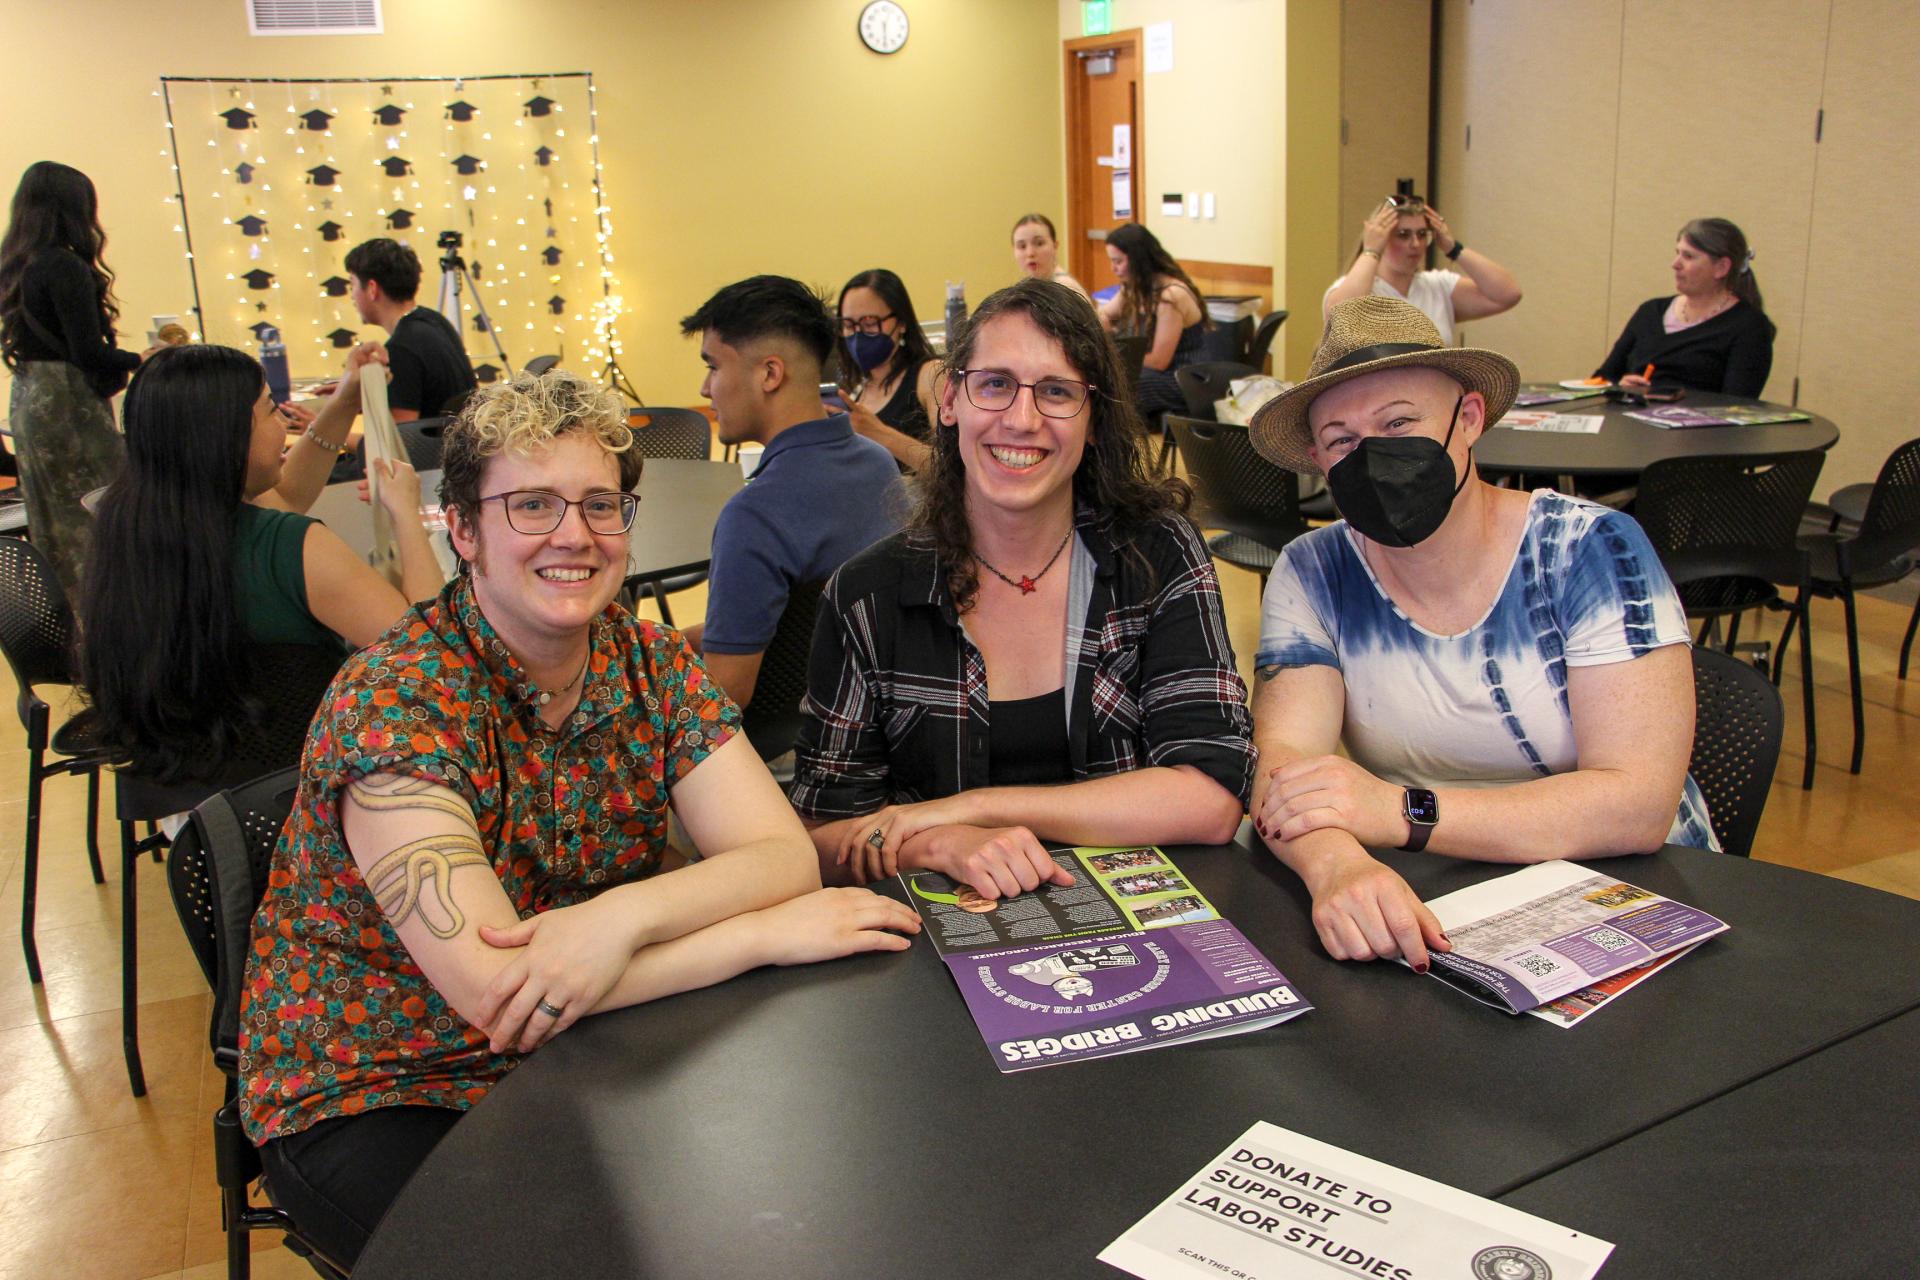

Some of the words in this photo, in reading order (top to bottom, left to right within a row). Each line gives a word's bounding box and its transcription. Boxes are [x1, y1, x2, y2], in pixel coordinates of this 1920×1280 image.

[1004, 994, 1050, 1013] LABOR
[1086, 991, 1143, 1012] CENTER
[1494, 981, 1510, 993] THE
[1053, 1005, 1083, 1014] FOR
[1151, 985, 1300, 1031] BUILDING
[1000, 1022, 1142, 1062] BRIDGES
[1209, 1169, 1341, 1223] SUPPORT
[1231, 1148, 1348, 1198] DONATE
[1353, 1191, 1392, 1214] TO
[1184, 1188, 1280, 1234] LABOR
[1283, 1227, 1413, 1280] STUDIES
[1177, 1247, 1206, 1262] SCAN
[1208, 1259, 1231, 1272] THIS
[1231, 1269, 1247, 1280] QR
